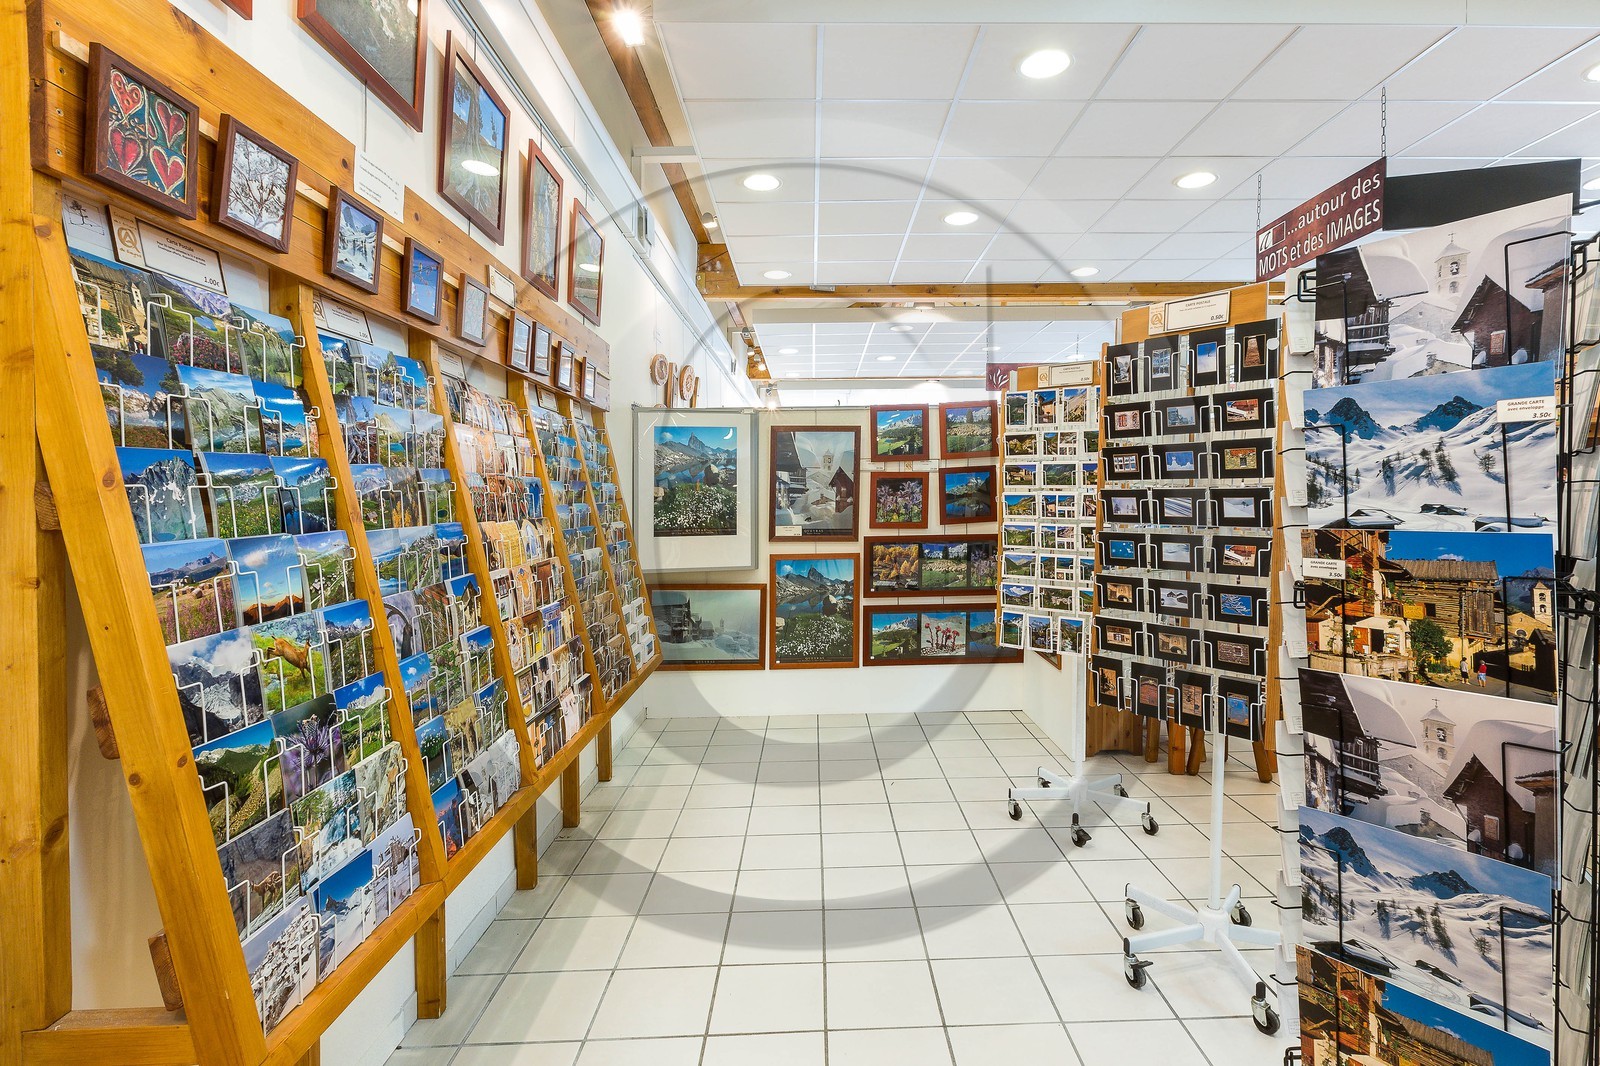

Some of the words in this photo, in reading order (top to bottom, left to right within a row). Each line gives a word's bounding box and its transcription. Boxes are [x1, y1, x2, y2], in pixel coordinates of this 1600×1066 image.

[1351, 173, 1381, 200] des
[1259, 246, 1288, 277] MOTS
[1290, 241, 1301, 261] et
[1303, 233, 1324, 255] des
[1326, 198, 1381, 244] IMAGES
